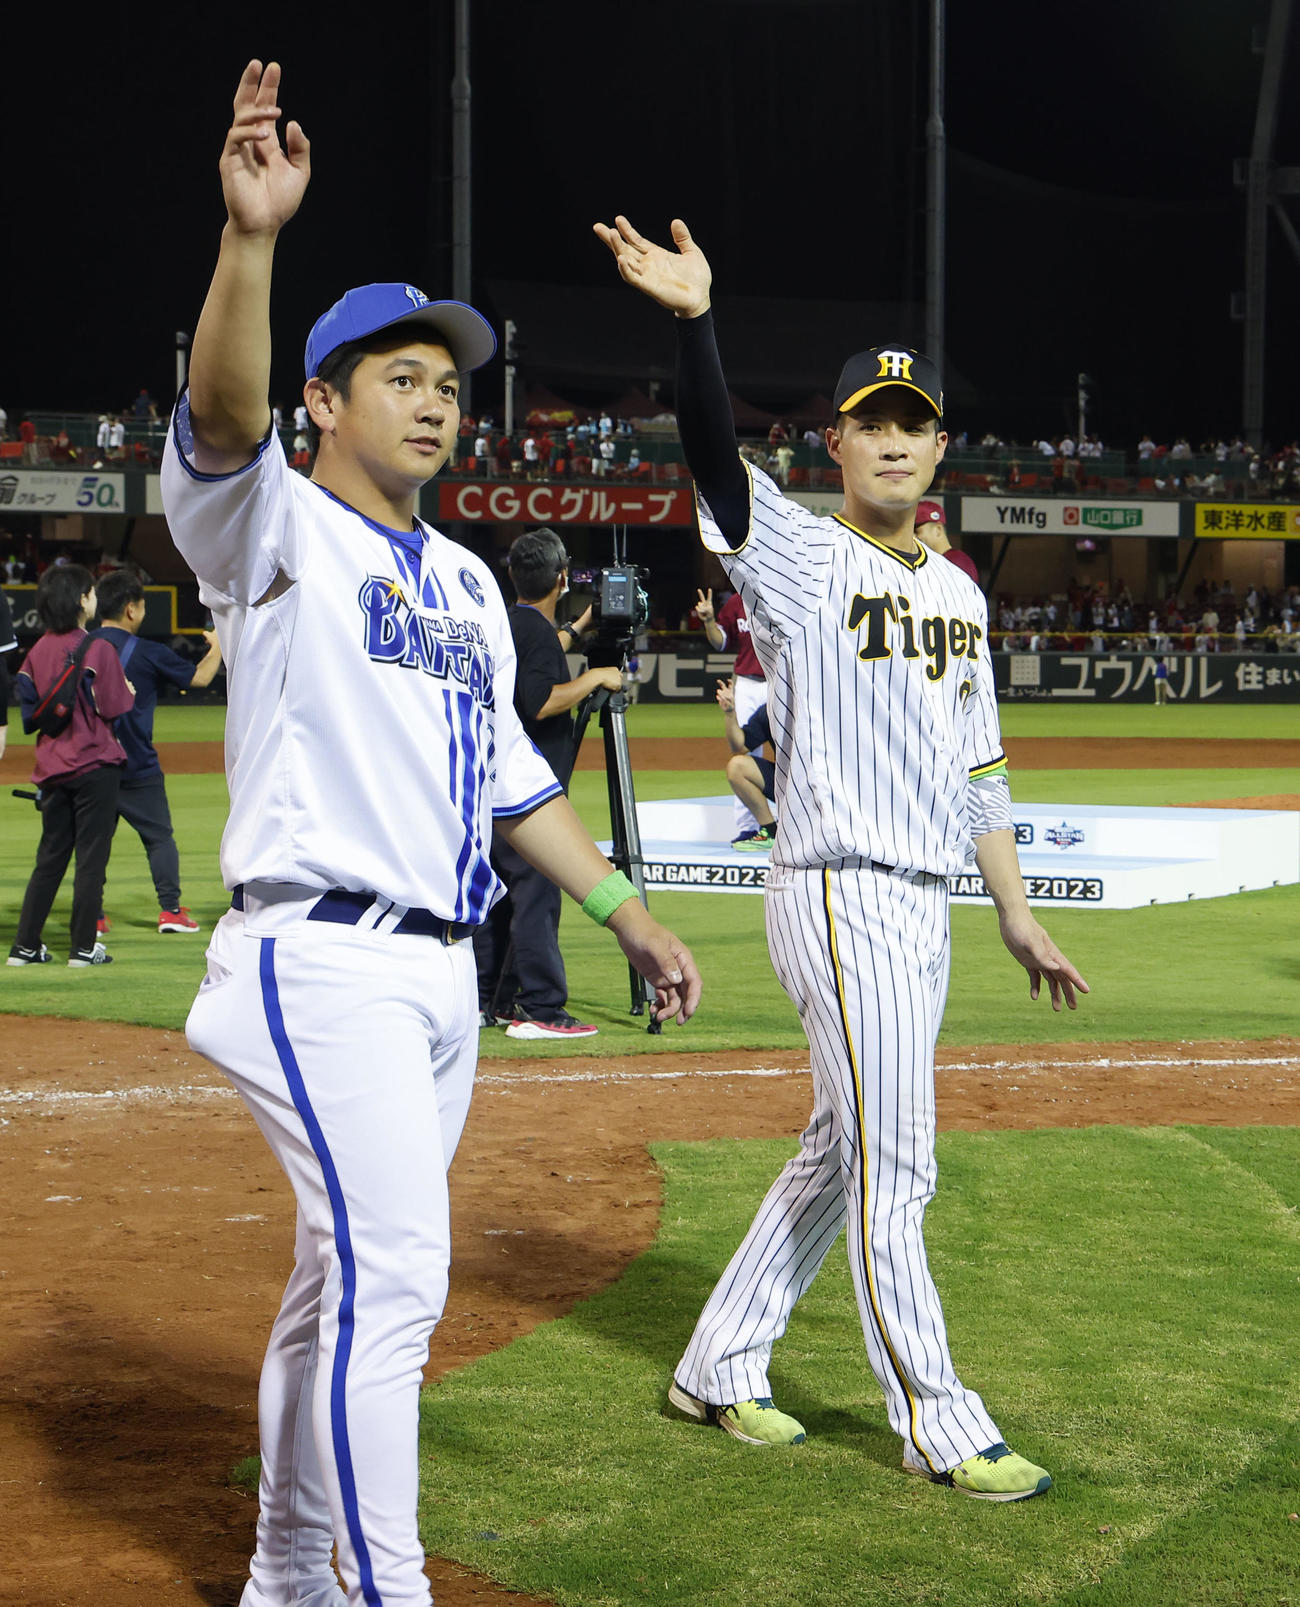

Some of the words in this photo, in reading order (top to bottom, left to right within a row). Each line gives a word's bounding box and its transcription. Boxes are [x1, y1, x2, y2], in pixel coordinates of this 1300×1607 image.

[456, 485, 677, 523] CGCグループ
[996, 506, 1048, 529] YMfg
[1203, 510, 1288, 532] 東洋水産
